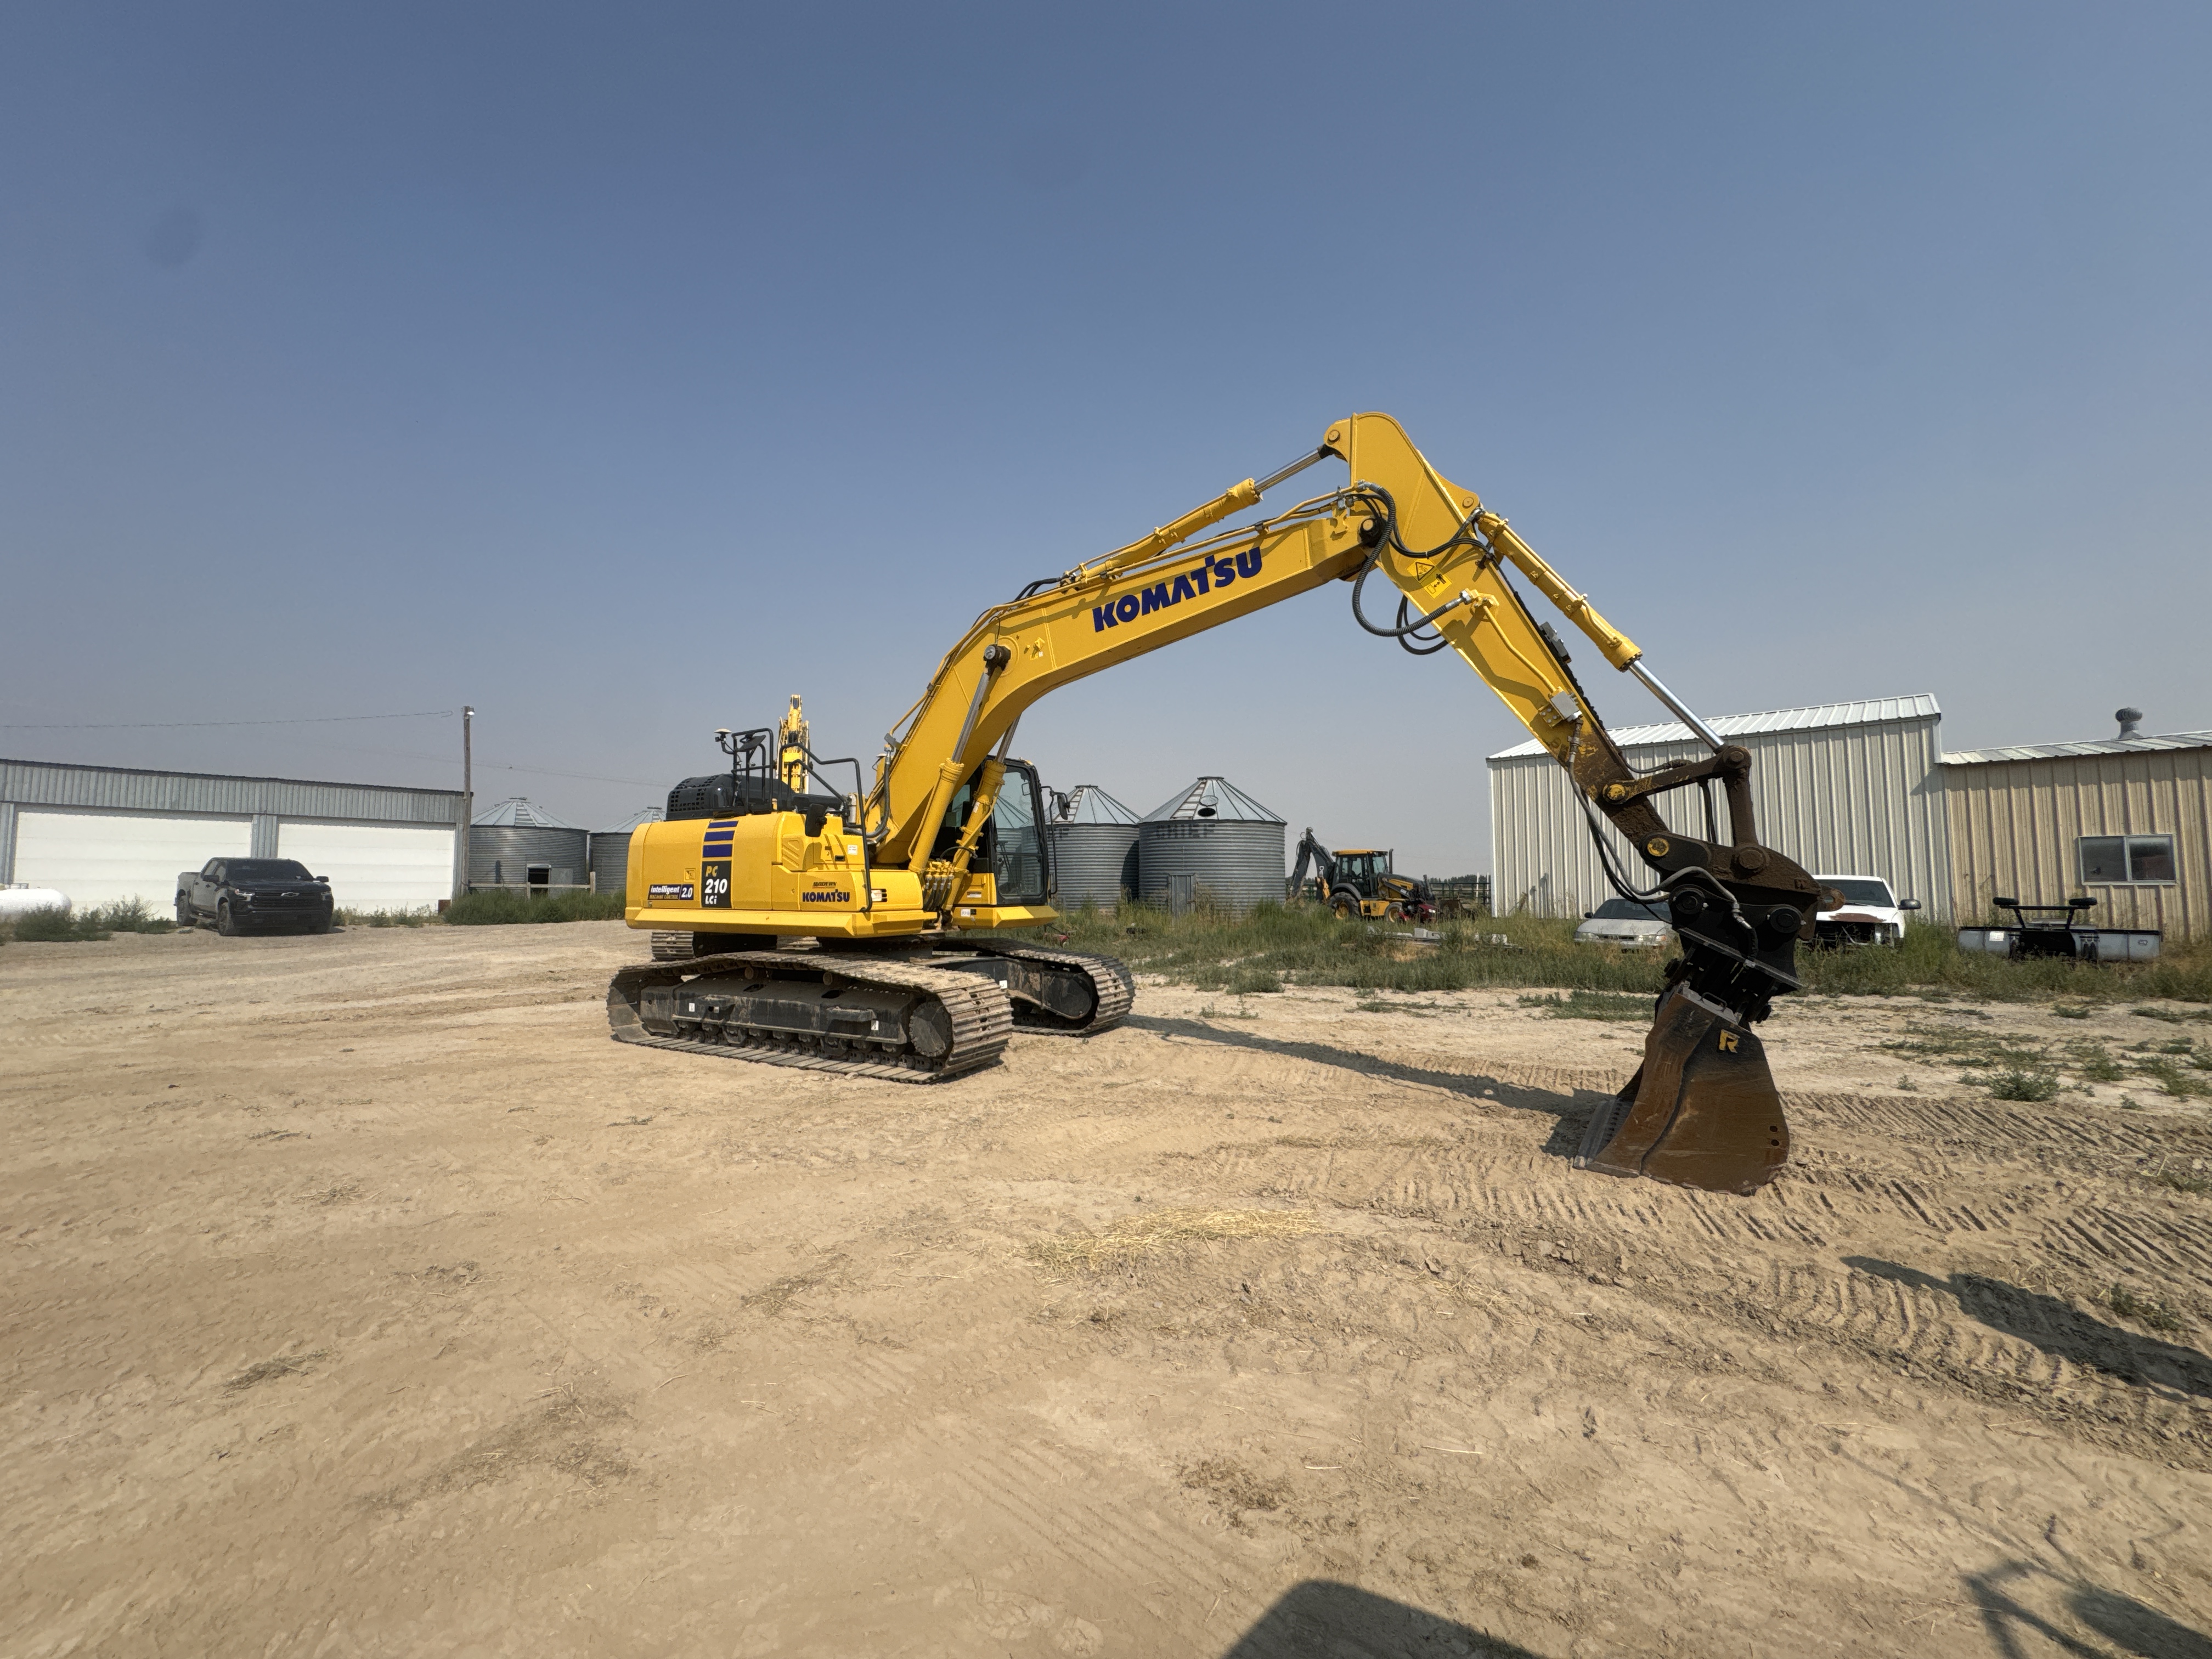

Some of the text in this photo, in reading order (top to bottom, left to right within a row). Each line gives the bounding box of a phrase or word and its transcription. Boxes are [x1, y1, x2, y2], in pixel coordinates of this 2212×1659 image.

[1092, 546, 1262, 633] KOMATSU
[1156, 824, 1215, 838] CHIEF
[706, 865, 718, 877] PC
[681, 887, 693, 898] 2.0
[704, 878, 728, 894] 210
[803, 889, 850, 902] KOMATSU
